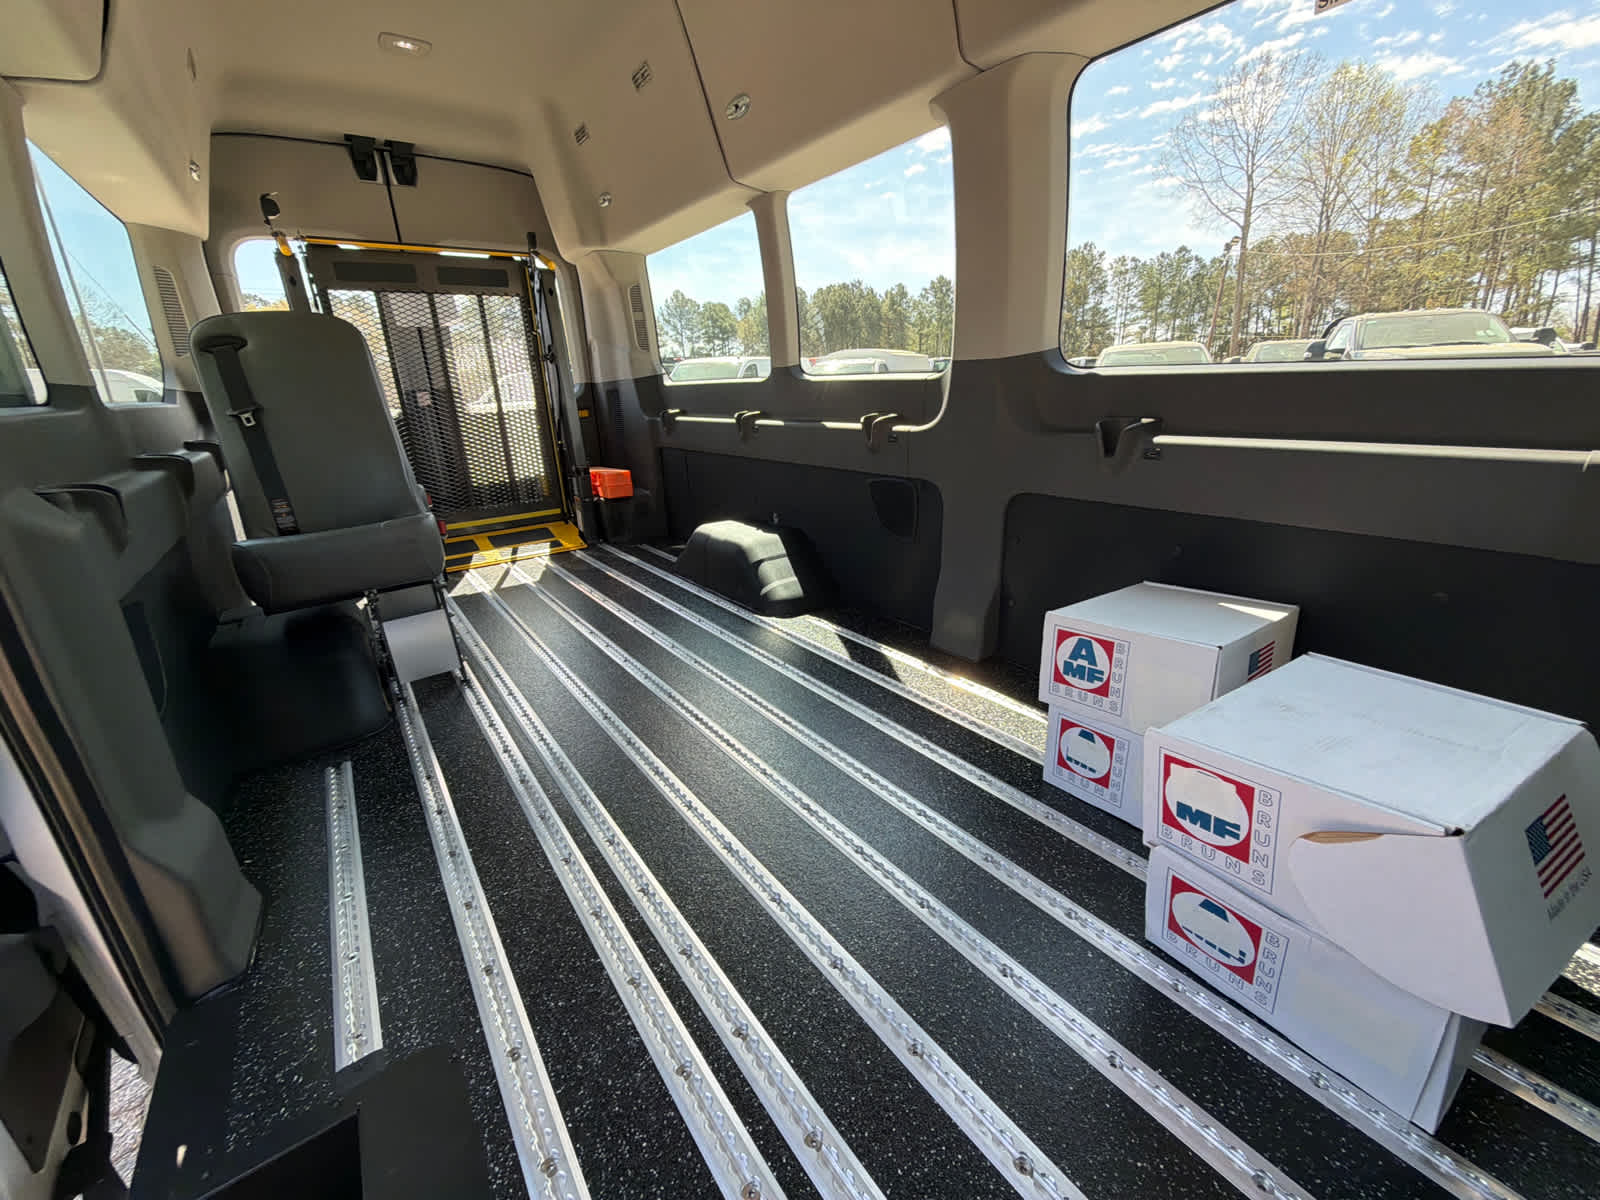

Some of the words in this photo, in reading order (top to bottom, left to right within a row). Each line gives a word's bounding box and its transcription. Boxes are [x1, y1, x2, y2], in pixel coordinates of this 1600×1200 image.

[1109, 643, 1126, 712] BRUNS
[1251, 789, 1273, 886] BRUNS
[1254, 931, 1280, 1006] BRUNS
